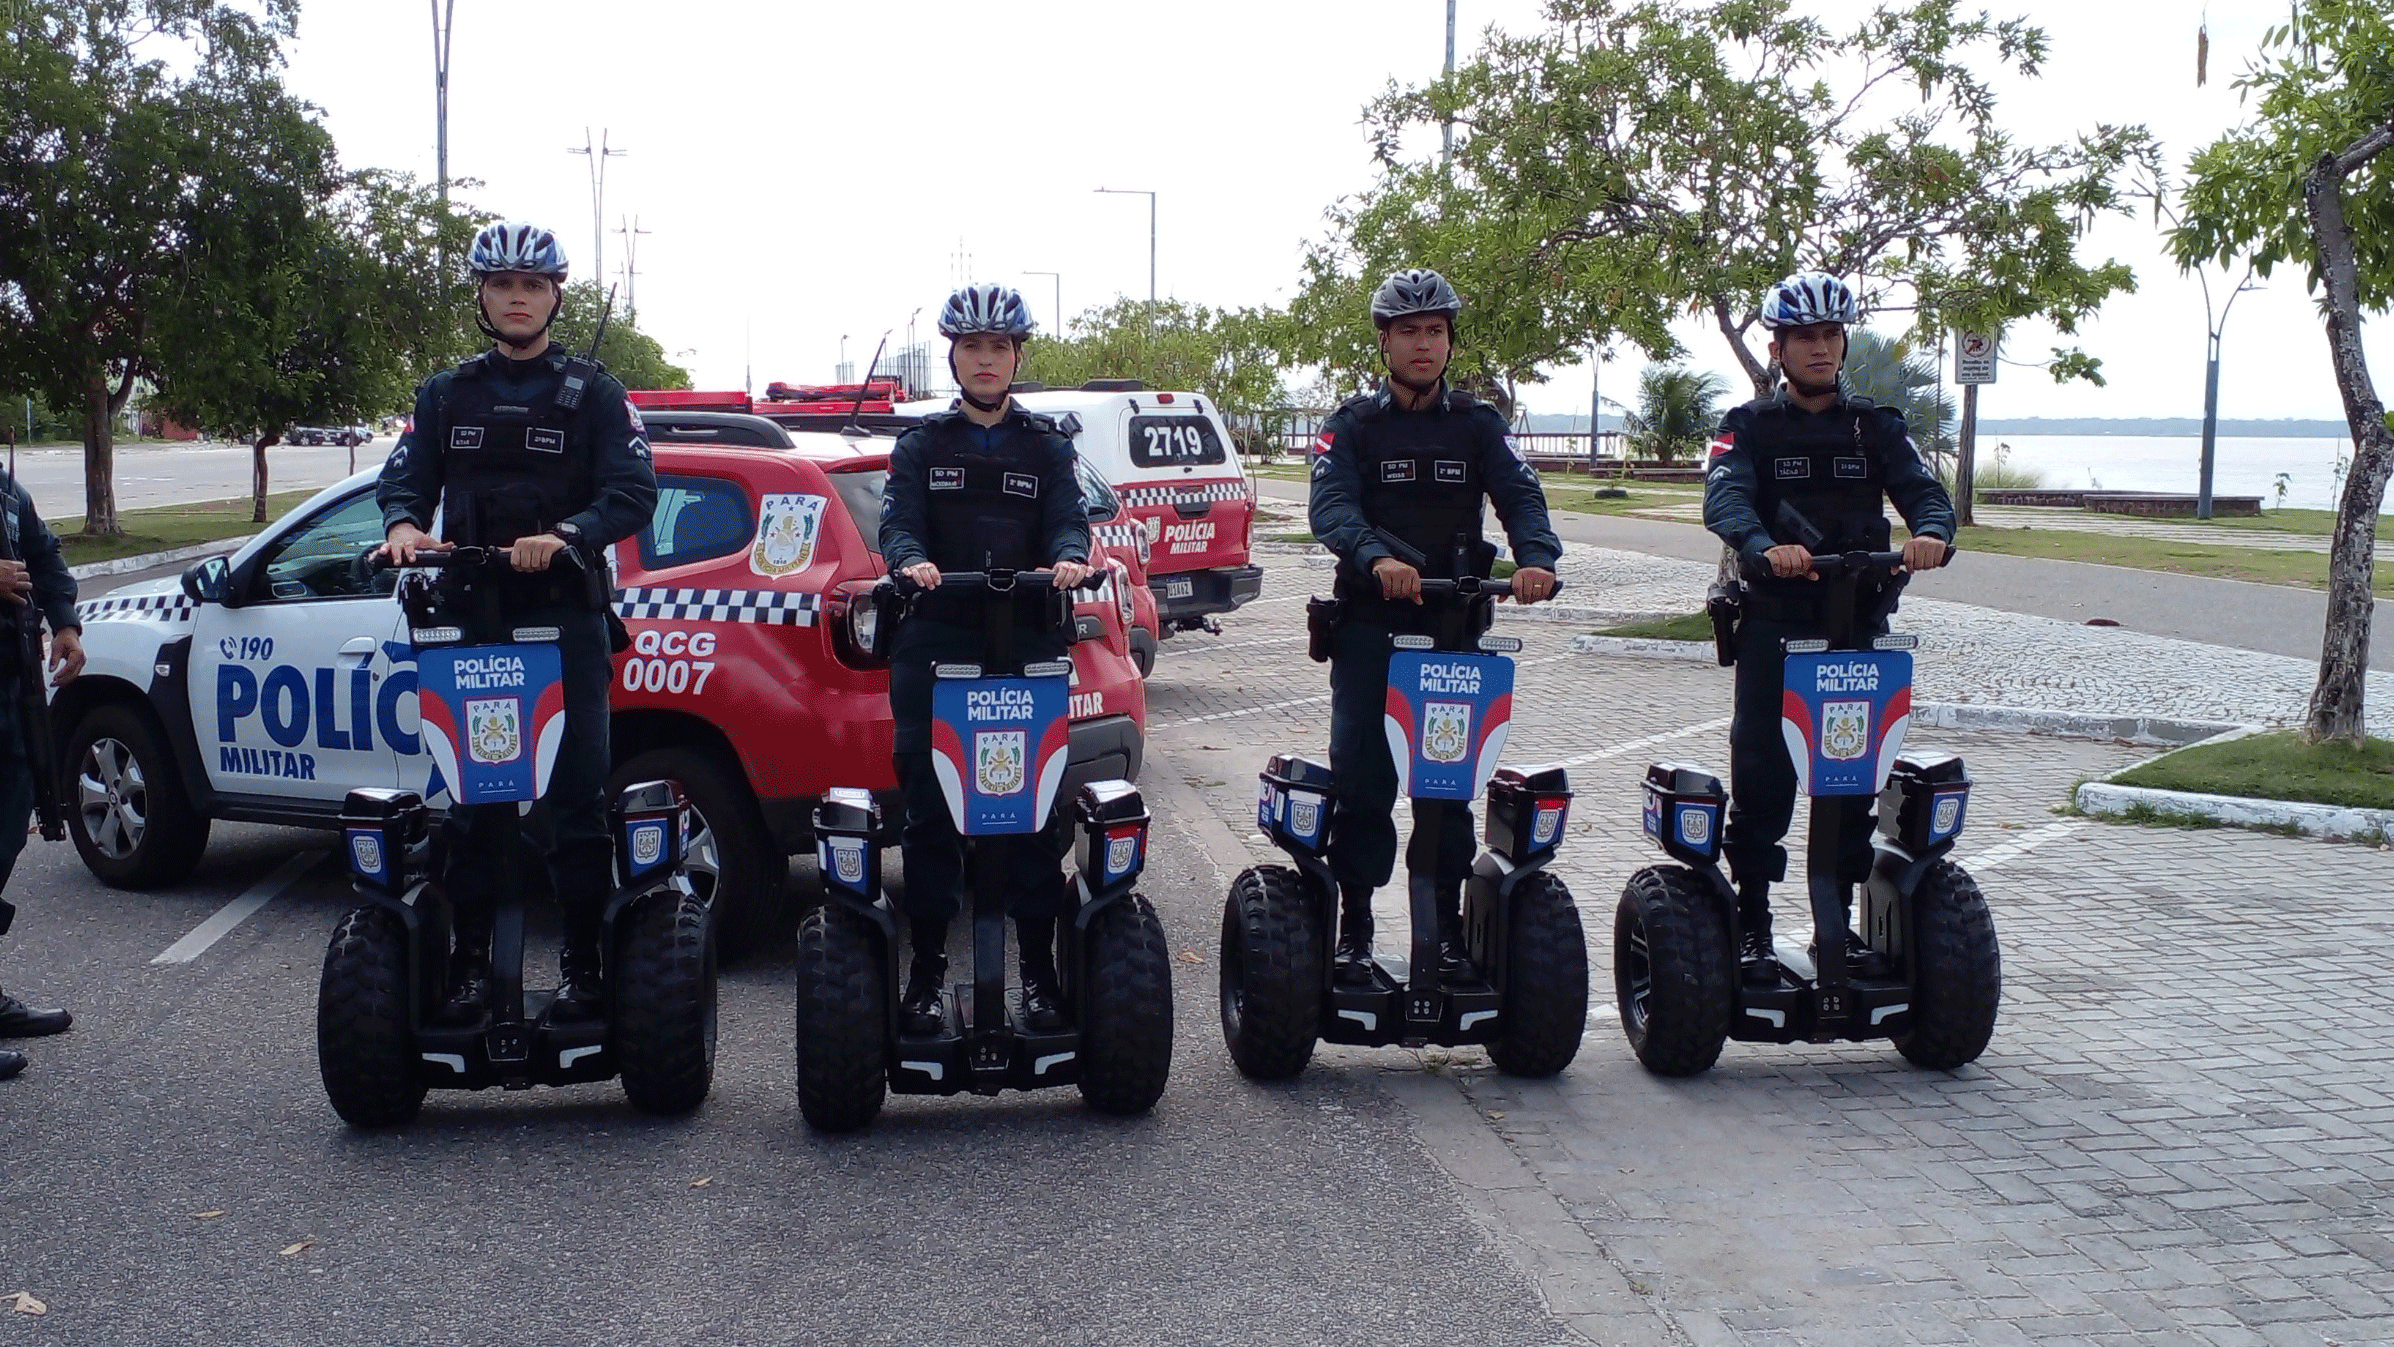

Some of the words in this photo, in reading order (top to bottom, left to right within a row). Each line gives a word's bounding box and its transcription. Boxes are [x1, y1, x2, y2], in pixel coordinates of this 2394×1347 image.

[1144, 425, 1202, 457] 2719
[1163, 519, 1216, 543] POLÍCIA
[1169, 540, 1208, 555] MILITAR
[240, 636, 274, 661] 190
[634, 630, 716, 657] QCG
[453, 654, 525, 674] POLÍCIA
[1420, 662, 1482, 681] POLÍCIA
[1816, 661, 1880, 678] POLÍCIA
[455, 672, 525, 690] MILITAR
[623, 657, 715, 695] 0007
[1816, 677, 1878, 693] MILITAR
[1419, 678, 1480, 695] MILITAR
[217, 652, 421, 756] POLÍC
[967, 687, 1034, 706] POLÍCIA
[967, 705, 1033, 721] MILITAR
[220, 746, 316, 780] MILITAR
